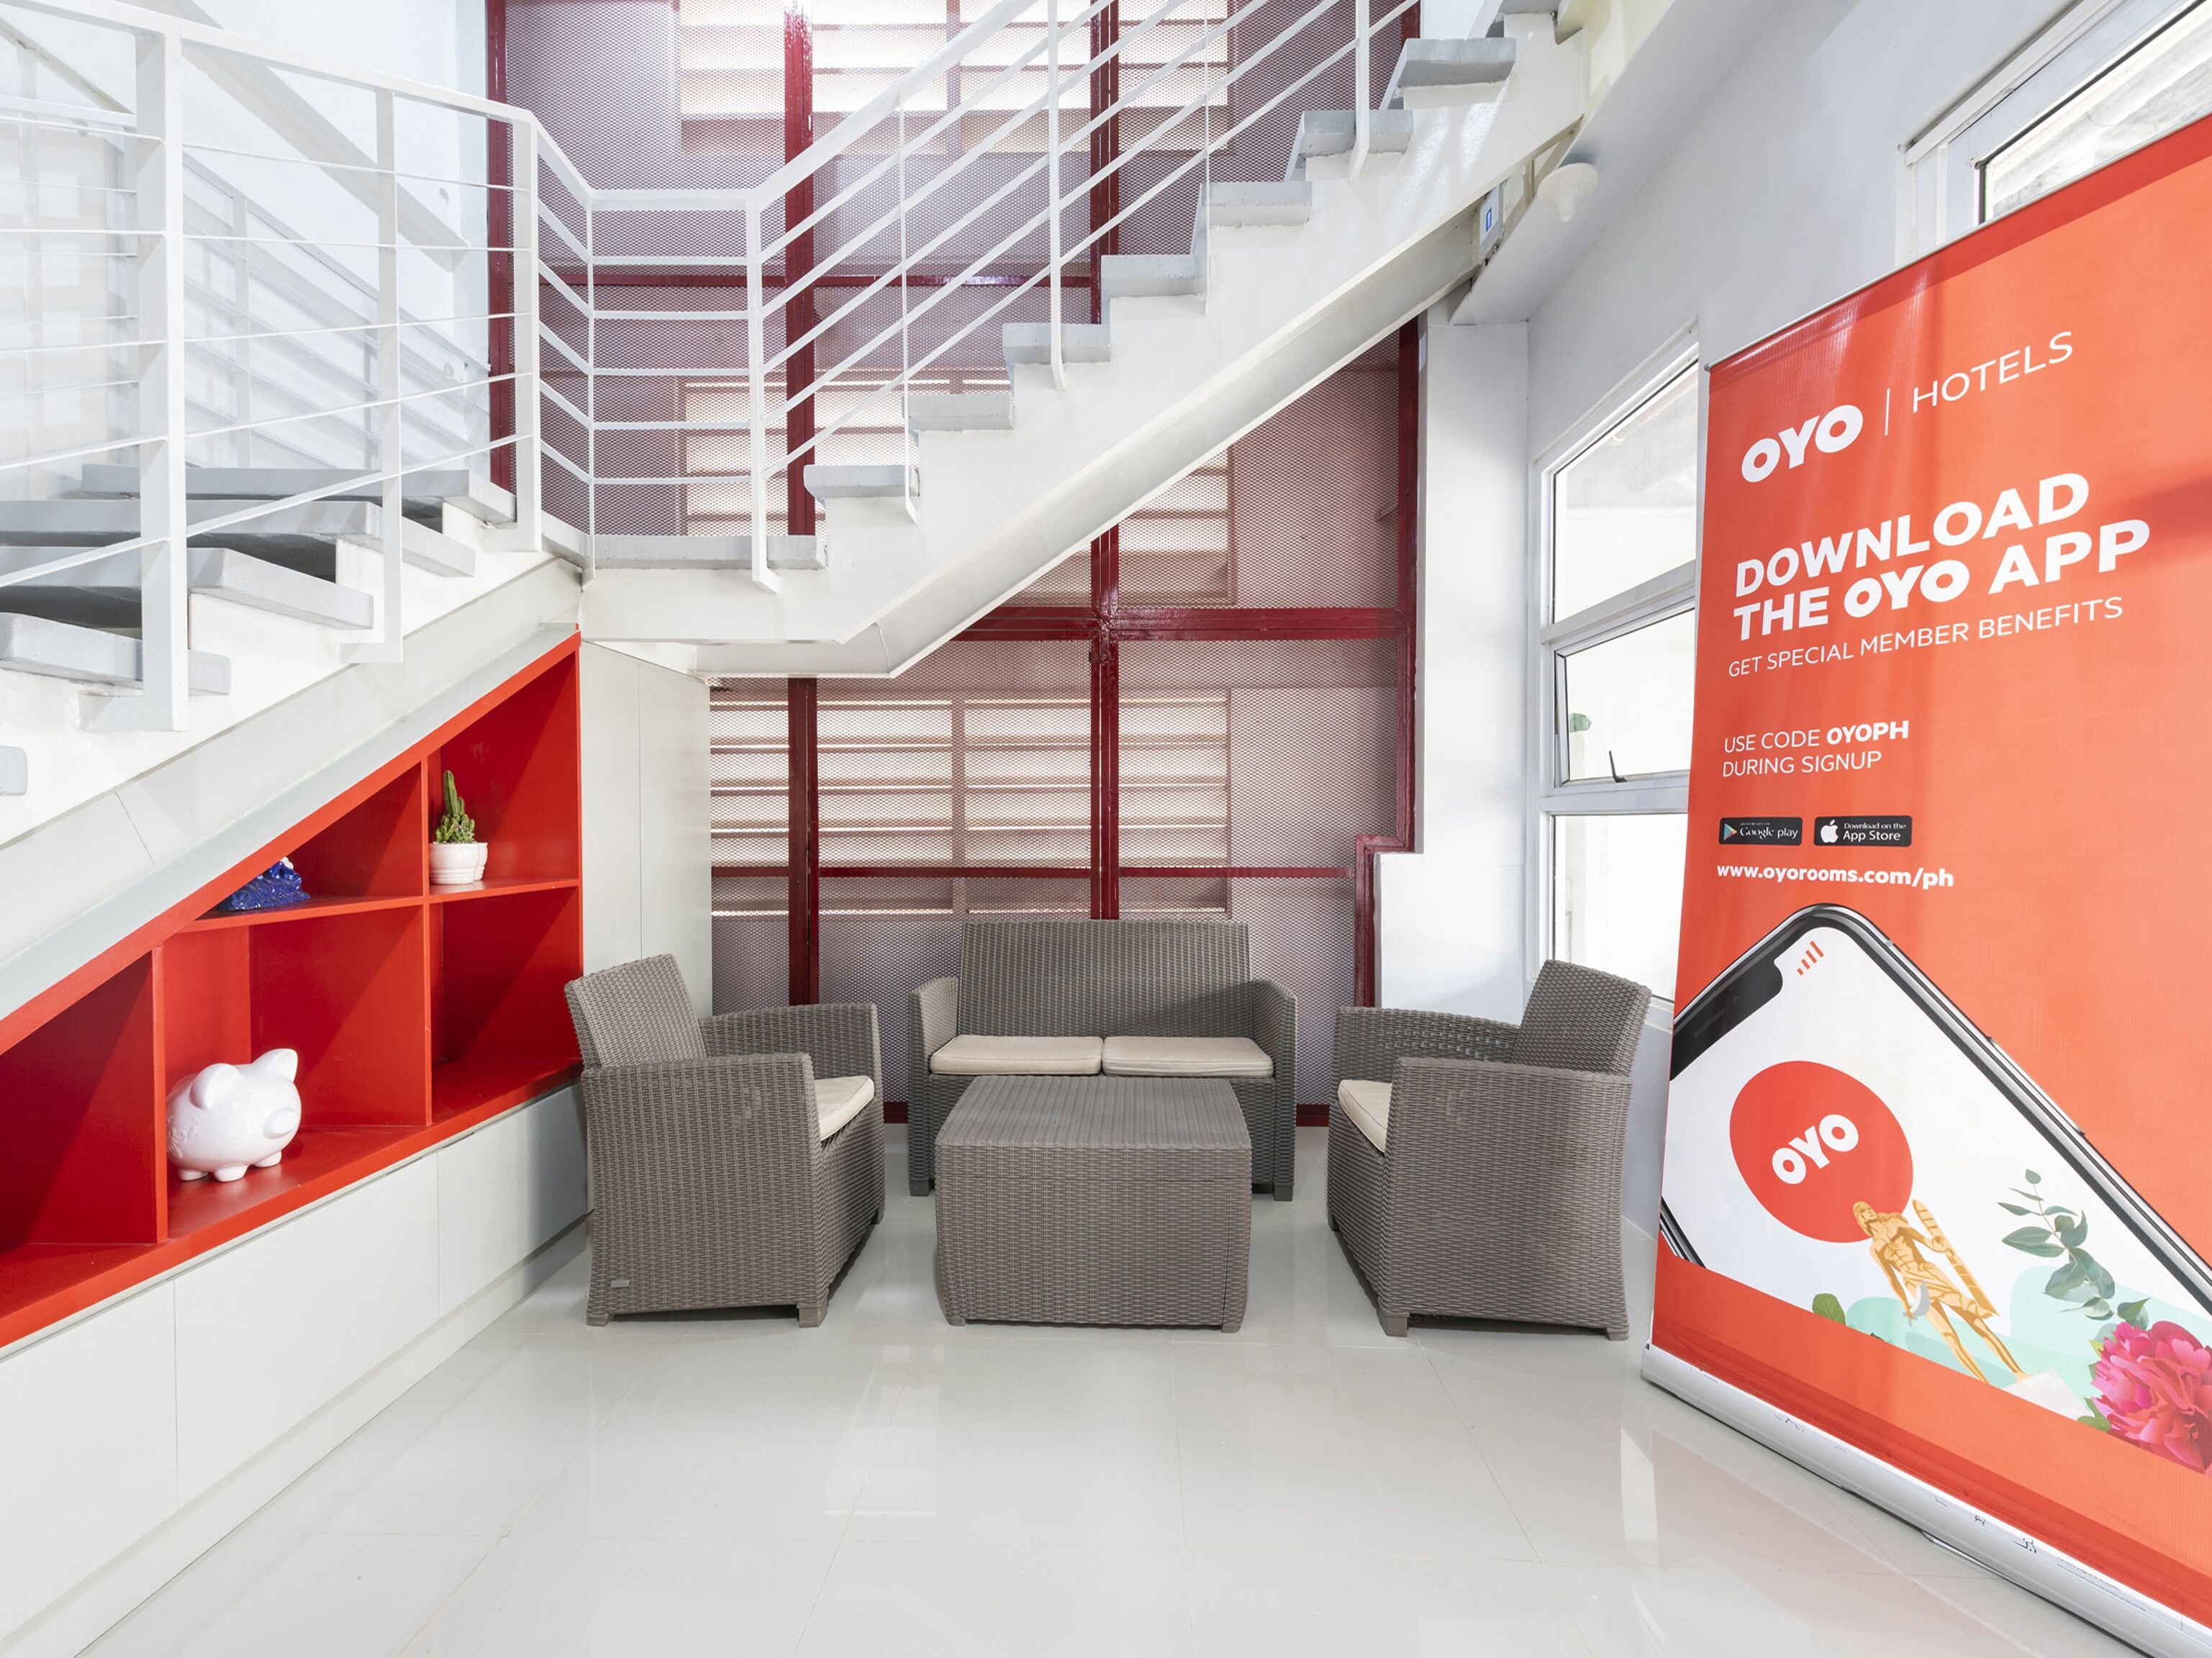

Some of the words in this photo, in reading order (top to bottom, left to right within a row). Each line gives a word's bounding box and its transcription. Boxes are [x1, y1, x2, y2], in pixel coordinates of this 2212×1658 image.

[1741, 404, 1864, 483] OYO
[1913, 331, 2073, 413] HOTELS
[1735, 473, 2089, 597] DOWNLOAD
[1733, 586, 1829, 640] THE
[1844, 559, 1970, 618] OYO
[1987, 519, 2150, 594] APP
[1728, 656, 1762, 677] GET
[1767, 642, 1854, 669] SPECIAL
[1860, 622, 1970, 656] MEMBER
[1978, 596, 2123, 639] BENEFITS
[1724, 734, 1756, 753] USE
[1761, 729, 1821, 749] CODE
[1826, 720, 1909, 745] OYOPH
[1723, 756, 1795, 777] DURING
[1801, 751, 1882, 773] SIGNUP
[1740, 827, 1774, 840] Google
[1777, 828, 1798, 839] play
[1843, 830, 1866, 842] App
[1869, 830, 1901, 841] Store
[1717, 866, 1954, 890] www.oyorooms.com/ph
[1772, 1114, 1859, 1184] OYO
